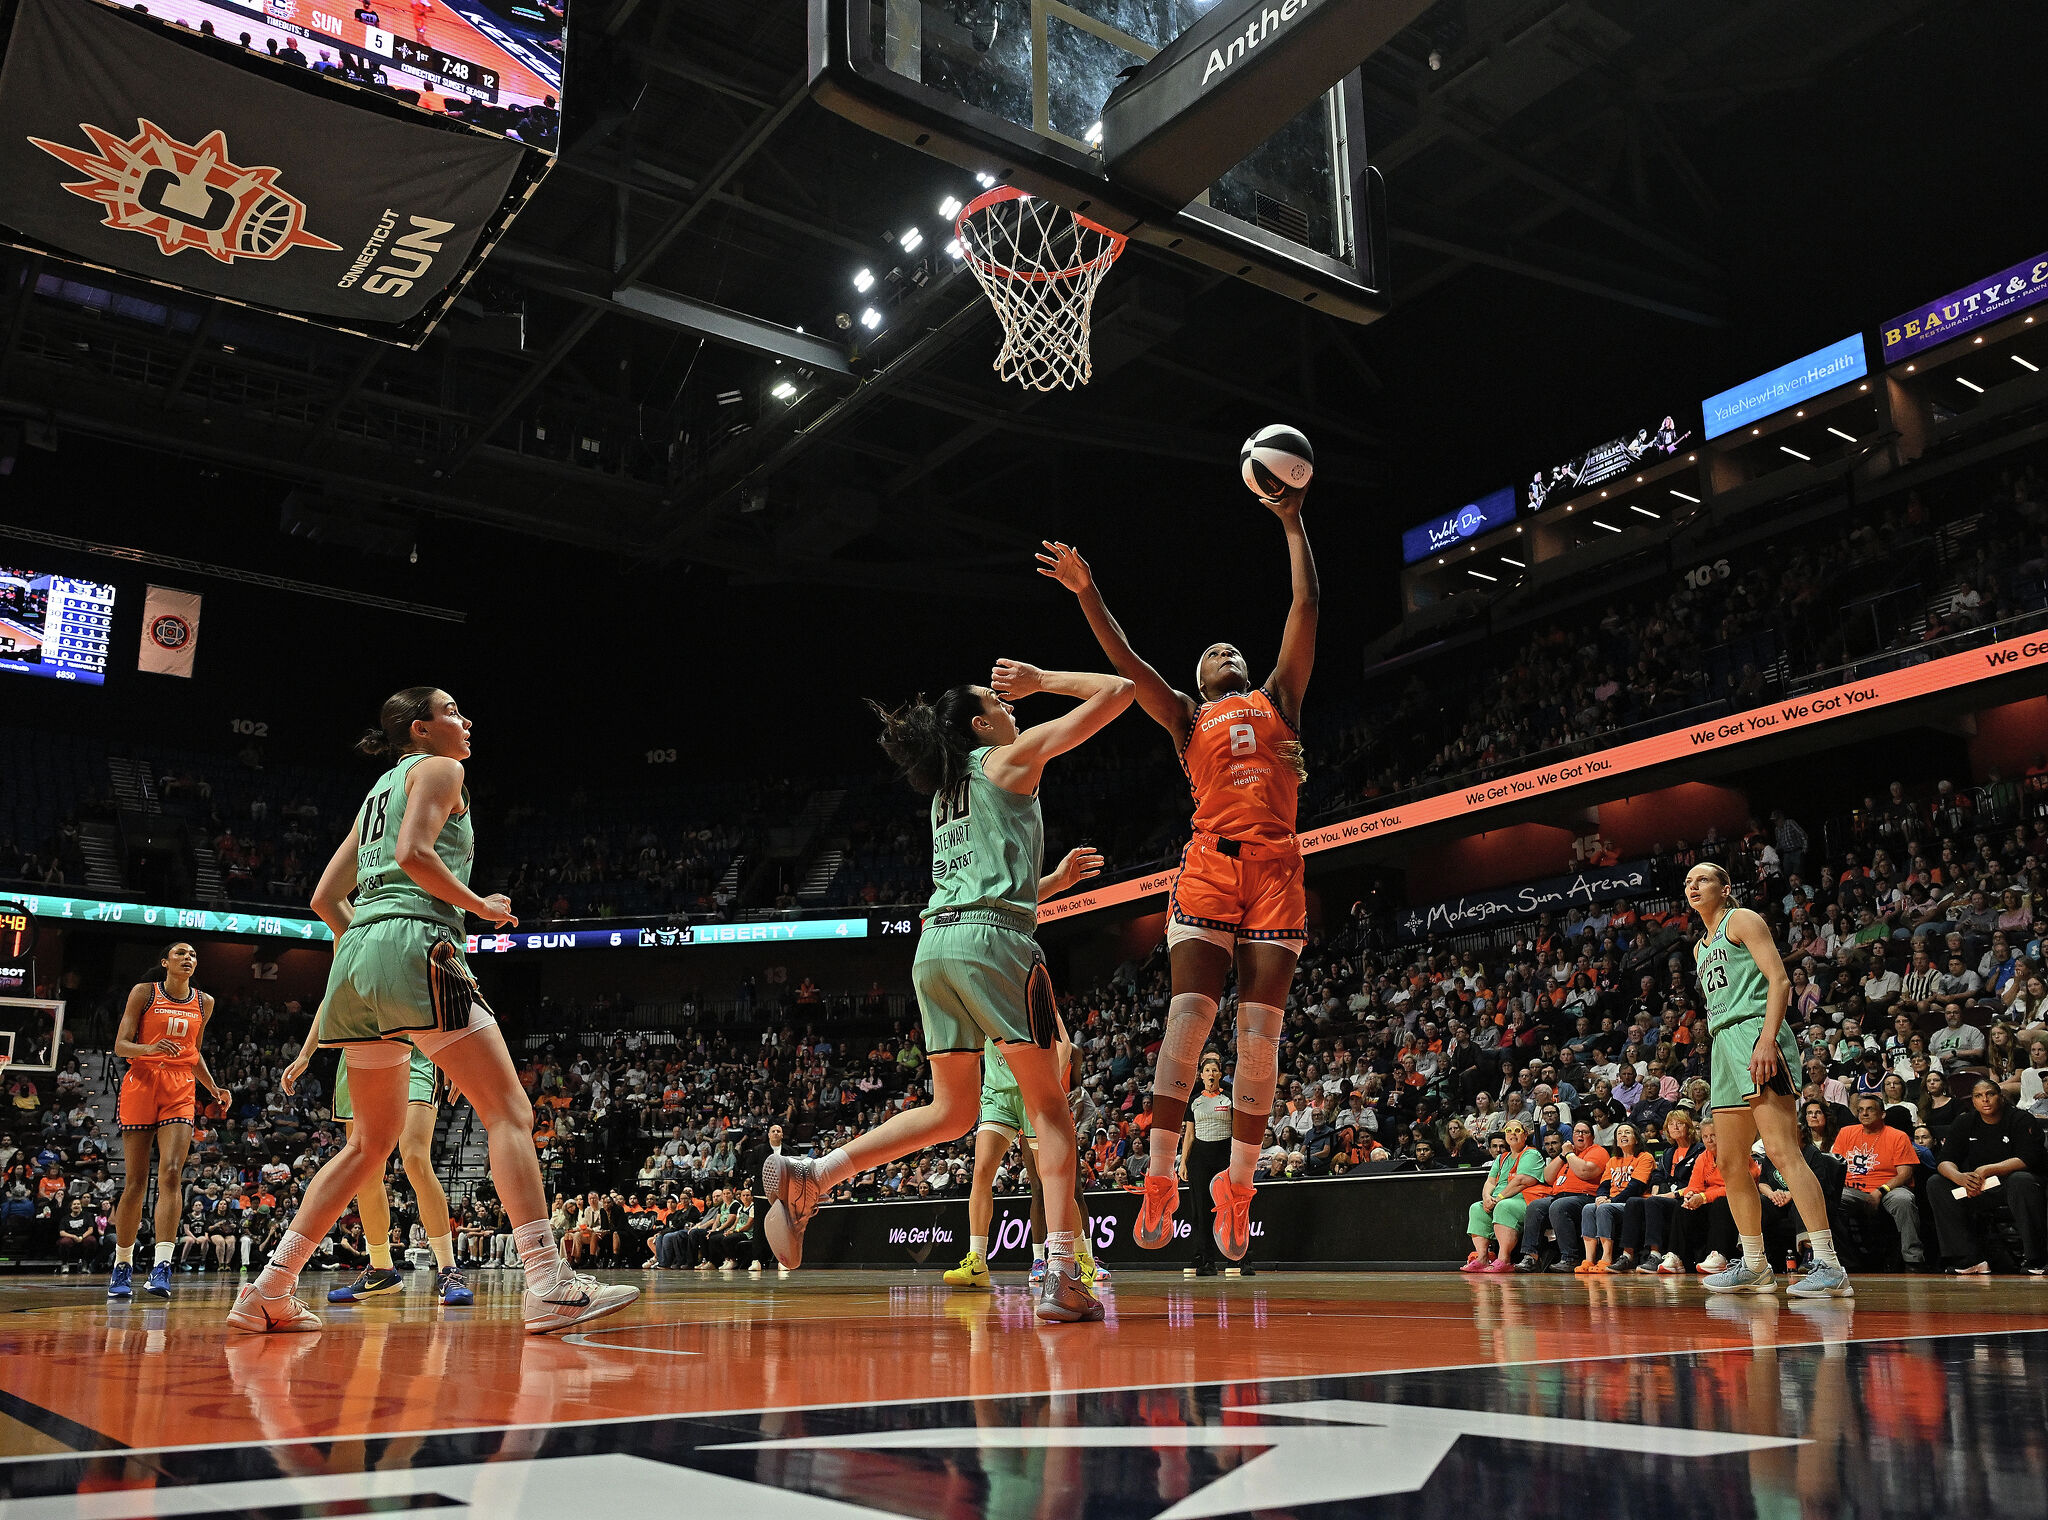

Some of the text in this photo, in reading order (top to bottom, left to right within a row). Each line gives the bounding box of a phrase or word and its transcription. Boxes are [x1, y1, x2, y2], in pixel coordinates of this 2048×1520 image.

[266, 15, 302, 36] TIMEOUTS:
[311, 10, 343, 35] SUN
[375, 34, 383, 48] 5
[415, 50, 495, 89] 1ST 7:48 12
[401, 63, 490, 102] CONNECTICUT SUNSET SEASON
[338, 208, 400, 288] CONNECTICUT
[362, 214, 456, 298] SUN
[1884, 283, 2002, 347] BEAUTY
[1920, 282, 2048, 340] RESTAURANT LOUNGE PAWN
[1714, 354, 1855, 421] YaleNewHavenHealth
[1428, 513, 1487, 543] Wolf Den
[1684, 559, 1731, 590] 106
[1986, 649, 2019, 667] We
[231, 718, 269, 737] 102
[1200, 708, 1274, 733] CONNECTICUT
[1690, 688, 1880, 745] We Get You. We Got You.
[1229, 723, 1257, 757] 8
[645, 749, 677, 764] 103
[1229, 763, 1245, 771] Yale
[1231, 767, 1272, 778] NewHaven
[1233, 774, 1260, 786] Health
[1465, 759, 1613, 806] We Get You. We Got You.
[360, 786, 393, 849] 18
[934, 823, 971, 855] STEWART
[1302, 816, 1402, 849] Get You. We Got You.
[358, 847, 382, 872] STIER
[1571, 833, 1602, 862] 15
[948, 850, 974, 873] AT&T
[1140, 881, 1152, 892] We
[1153, 877, 1168, 889] Get
[1042, 908, 1056, 917] You.
[1056, 904, 1068, 913] We
[1069, 900, 1082, 911] Got
[1082, 897, 1097, 907] You.
[1426, 872, 1643, 930] Mohegan Sun Arena
[0, 914, 27, 931] :48
[62, 902, 73, 916] 1
[144, 909, 157, 923] 0
[178, 910, 206, 928] FGM
[226, 917, 239, 930] 2
[257, 917, 282, 935] FGA
[301, 923, 313, 938] 4
[527, 934, 576, 948] SUN
[610, 932, 622, 946] 5
[700, 925, 798, 941] LIBERTY
[836, 923, 848, 936] 4
[881, 920, 911, 934] 7:48
[0, 967, 26, 977] SOT
[251, 962, 279, 980] 12
[764, 967, 788, 984] 13
[1707, 965, 1729, 993] 23
[154, 1008, 199, 1019] CONNECTICUT
[166, 1016, 189, 1038] 10
[888, 1227, 953, 1244] We Get You.
